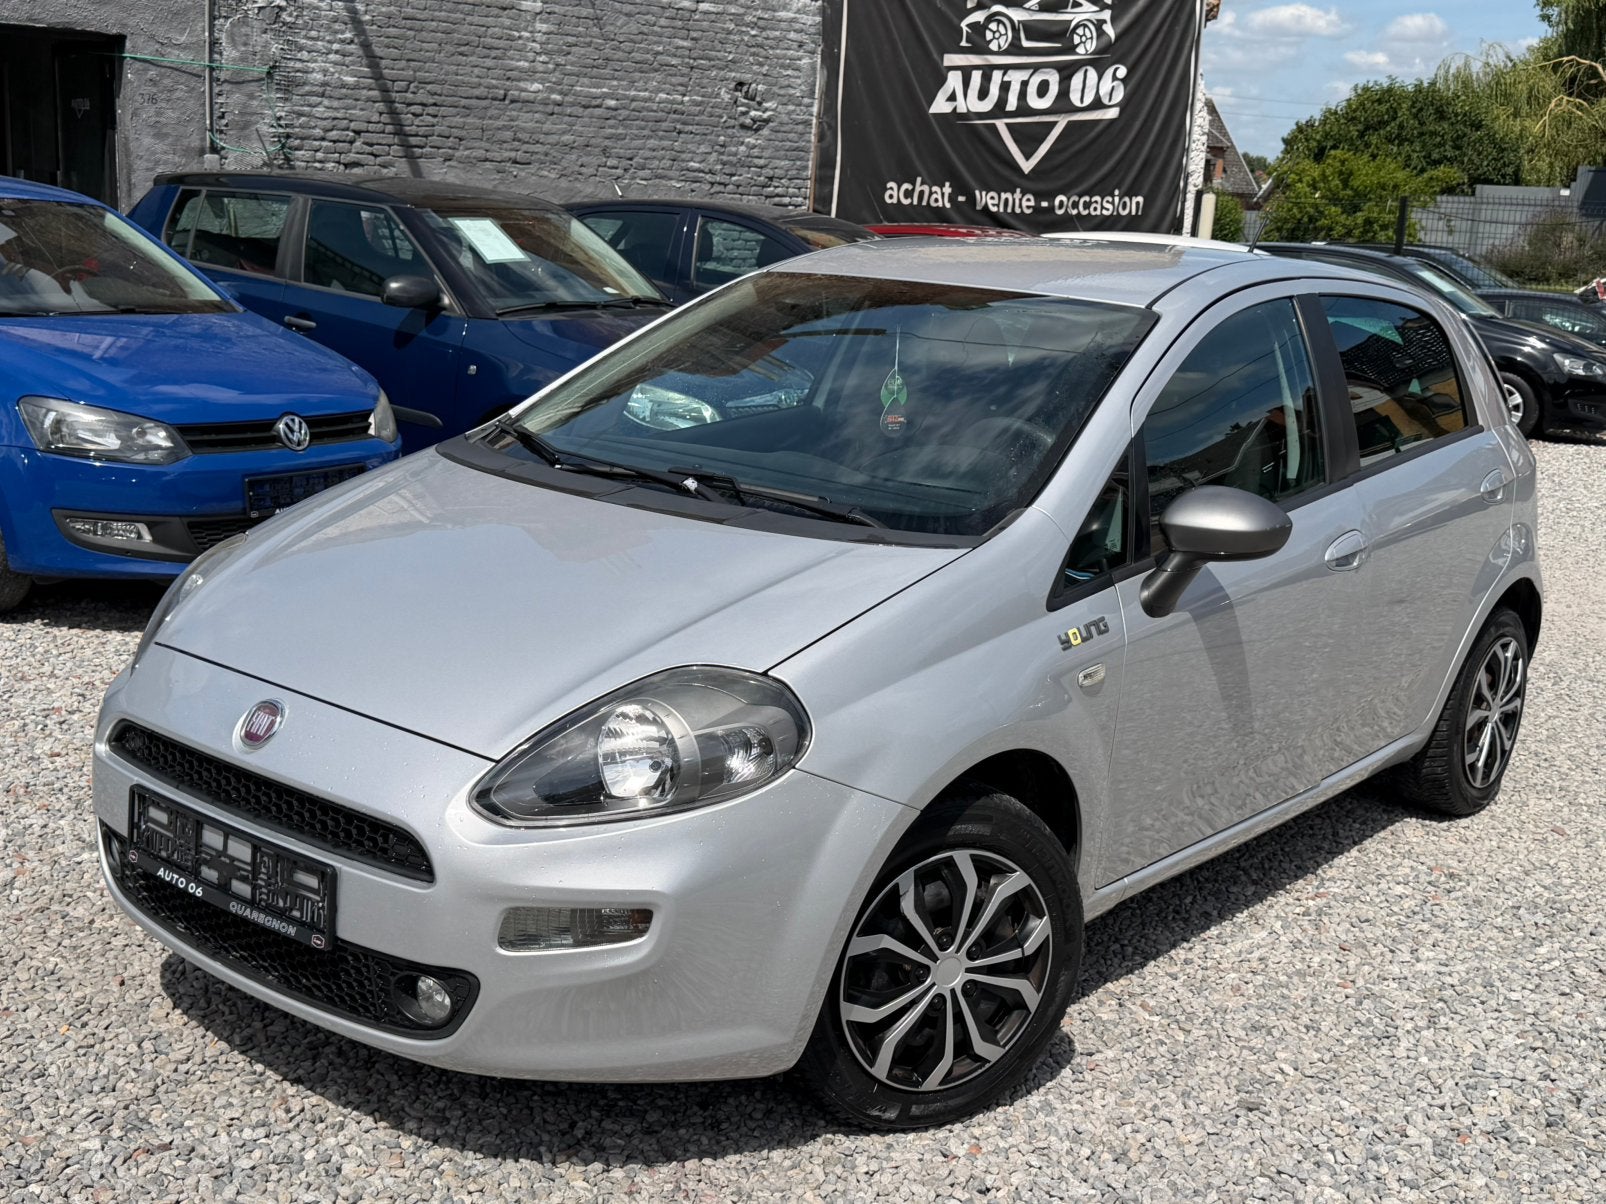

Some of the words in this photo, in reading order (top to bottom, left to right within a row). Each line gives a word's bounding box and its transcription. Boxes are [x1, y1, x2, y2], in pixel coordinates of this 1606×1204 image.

[929, 69, 1060, 114] AUTO
[1069, 64, 1127, 107] 06
[884, 177, 951, 209] achat
[975, 189, 1034, 215] vente
[1054, 189, 1144, 216] occasion
[246, 710, 275, 736] FIAT
[157, 867, 186, 888] AUTO
[188, 881, 203, 897] 06
[229, 902, 296, 935] QUAREGNON
